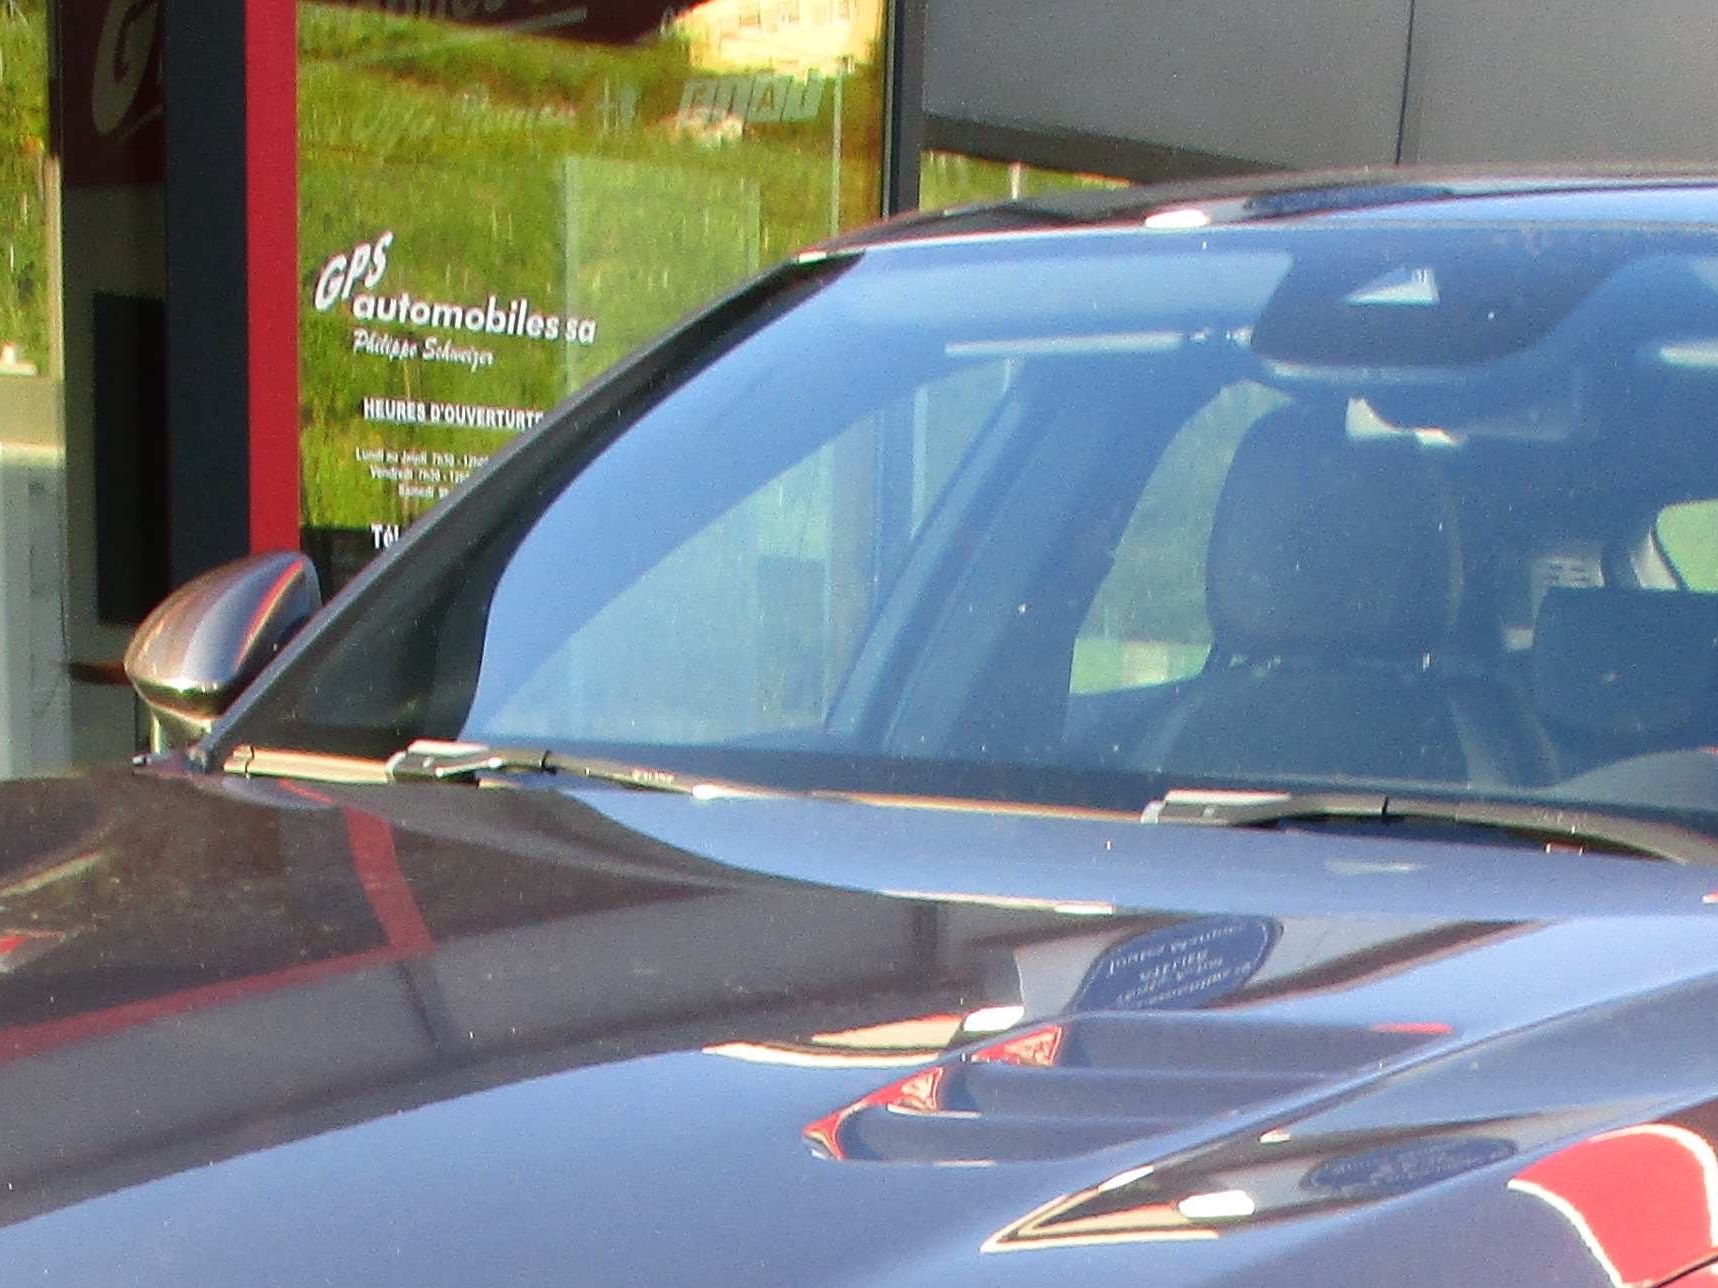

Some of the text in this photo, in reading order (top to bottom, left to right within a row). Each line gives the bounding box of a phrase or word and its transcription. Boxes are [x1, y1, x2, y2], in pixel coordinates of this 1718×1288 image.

[314, 230, 394, 312] GPS
[353, 292, 597, 345] automobiles sa
[363, 397, 426, 421] HEURES
